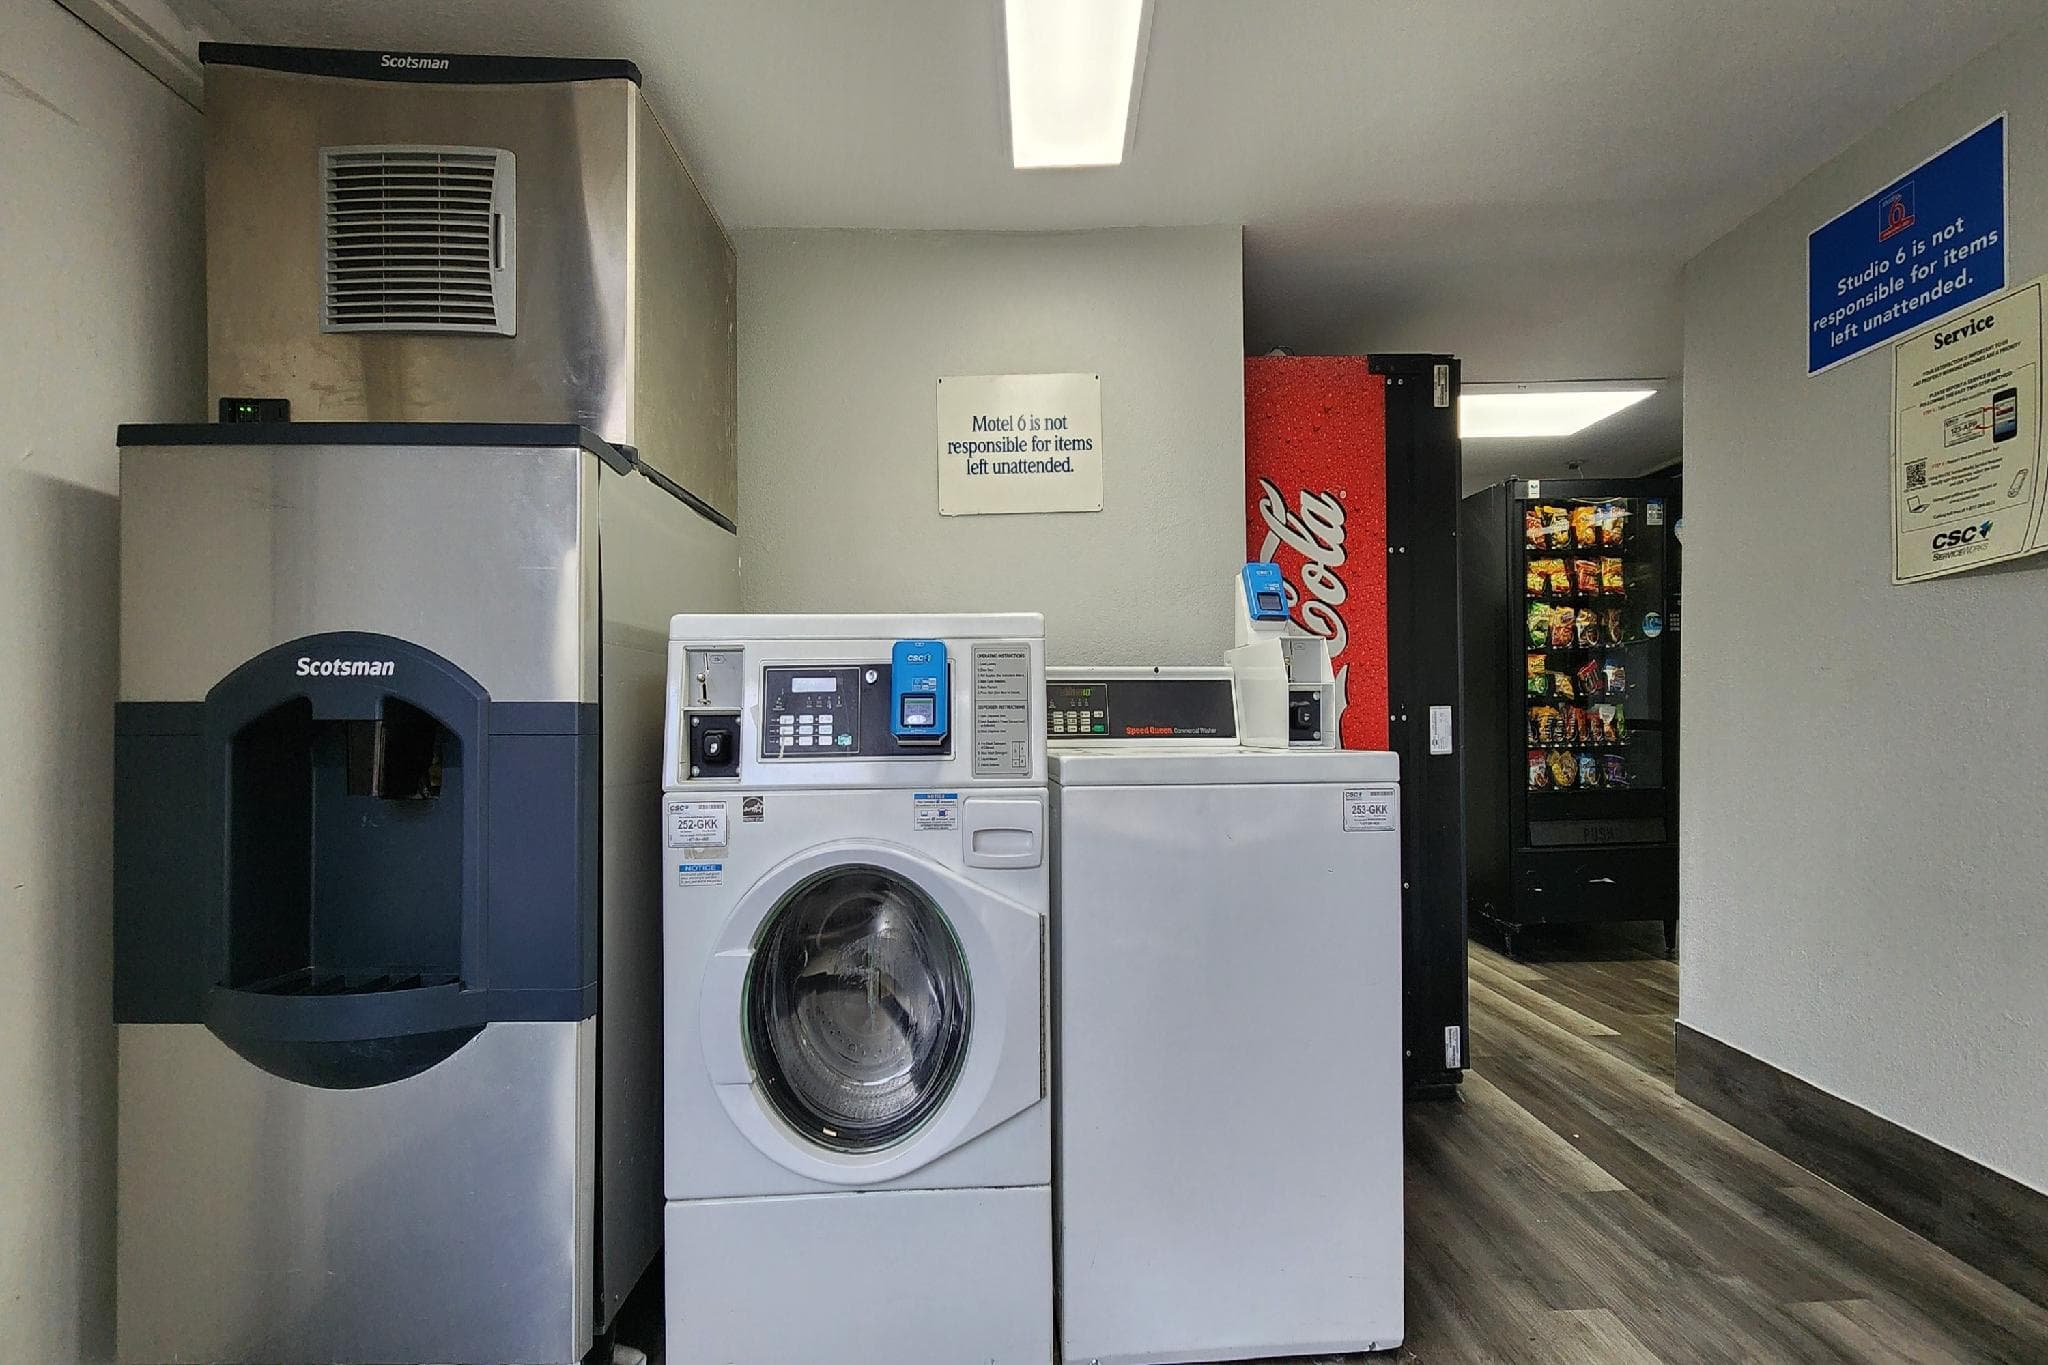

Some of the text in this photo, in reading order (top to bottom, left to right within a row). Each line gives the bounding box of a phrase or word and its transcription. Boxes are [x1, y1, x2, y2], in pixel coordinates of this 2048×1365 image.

[381, 54, 449, 69] Scotsman
[1837, 259, 1890, 296] Studio
[1895, 246, 1906, 264] 6
[1912, 239, 1926, 257] is
[1932, 217, 1964, 247] not
[1813, 230, 1998, 332] responsible for items
[1831, 268, 1973, 347] left unattended.
[1934, 315, 1995, 350] Service
[972, 414, 1068, 432] Motel 6 is not
[948, 435, 1093, 458] responsible for items
[967, 457, 1074, 475] left unattended.
[1932, 526, 1977, 550] CSC
[296, 657, 395, 676] Scotsman
[1126, 726, 1149, 735] Speed
[1149, 726, 1173, 734] Queen
[1351, 804, 1388, 815] 253-GKK
[678, 819, 718, 830] 252-GKK
